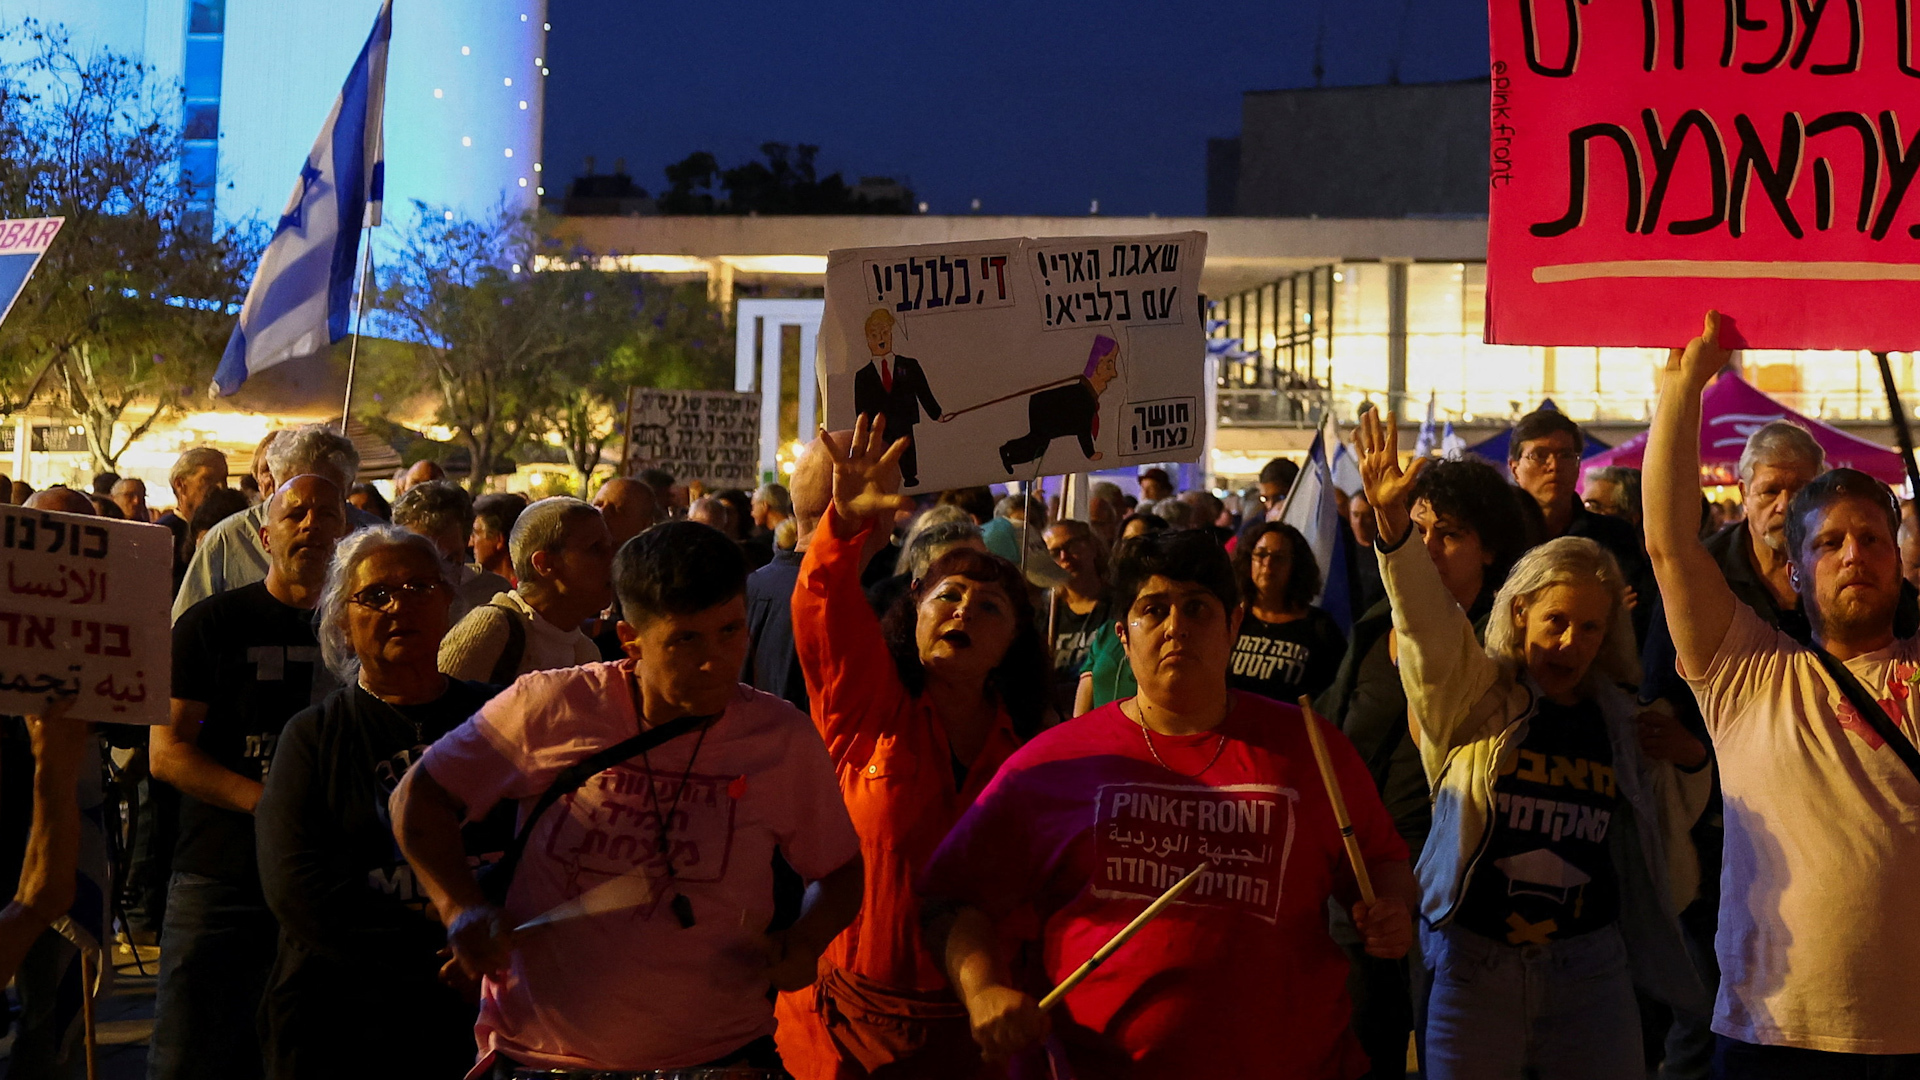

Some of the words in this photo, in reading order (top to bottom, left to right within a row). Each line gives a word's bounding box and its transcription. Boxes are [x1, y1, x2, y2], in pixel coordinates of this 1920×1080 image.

[1036, 249, 1100, 287] הארי!
[1108, 243, 1179, 278] שאגת
[1045, 282, 1132, 327] כלביא!
[1142, 286, 1177, 320] עם
[1134, 403, 1189, 431] חושך
[4, 513, 109, 560] כולנו
[71, 618, 131, 658] בני
[1110, 792, 1276, 835] PINKFRONT
[1106, 857, 1185, 889] הורודה
[1195, 870, 1270, 907] החזית
